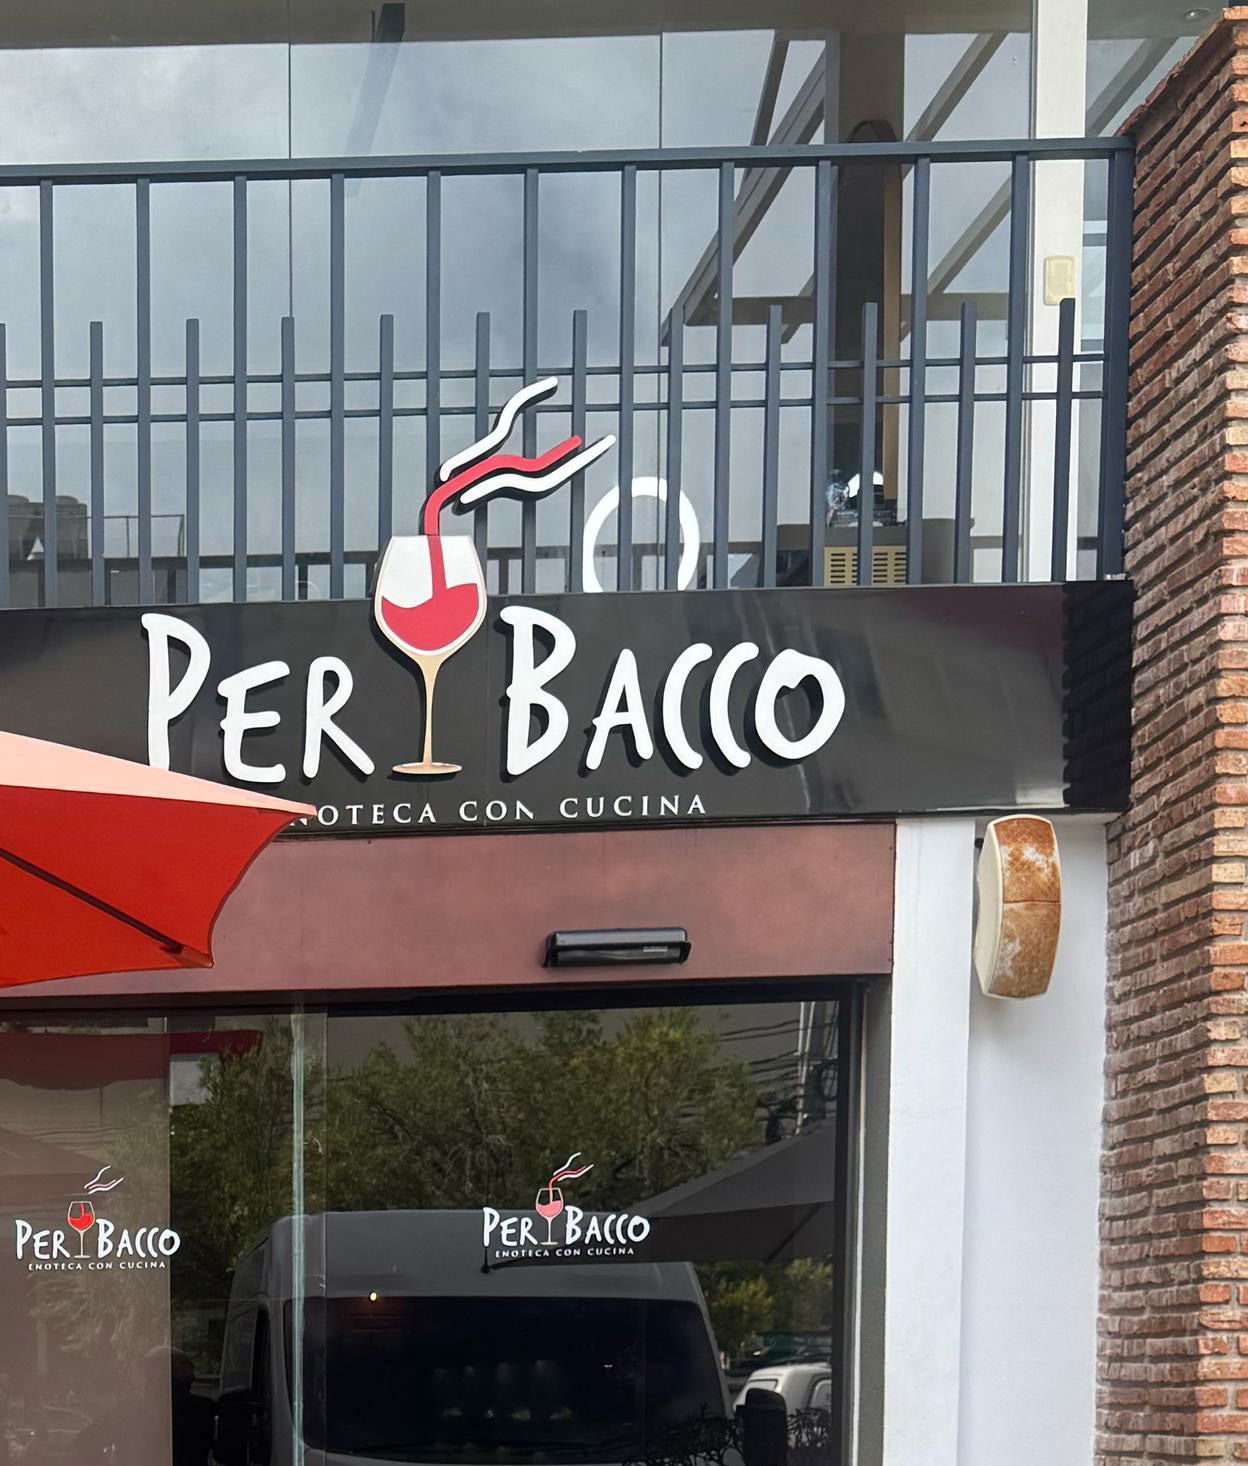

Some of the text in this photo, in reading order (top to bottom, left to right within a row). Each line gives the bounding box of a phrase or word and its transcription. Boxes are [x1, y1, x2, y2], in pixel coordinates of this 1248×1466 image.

[141, 605, 846, 783] PER BACCO
[458, 799, 535, 822] CON
[559, 794, 707, 818] CUCINA
[15, 1218, 181, 1260] PER BACCO
[482, 1205, 651, 1247] PER BACCO
[28, 1261, 166, 1271] ENOTECA CON CUCINA
[495, 1247, 635, 1258] ENOTECA CON CUCINA
